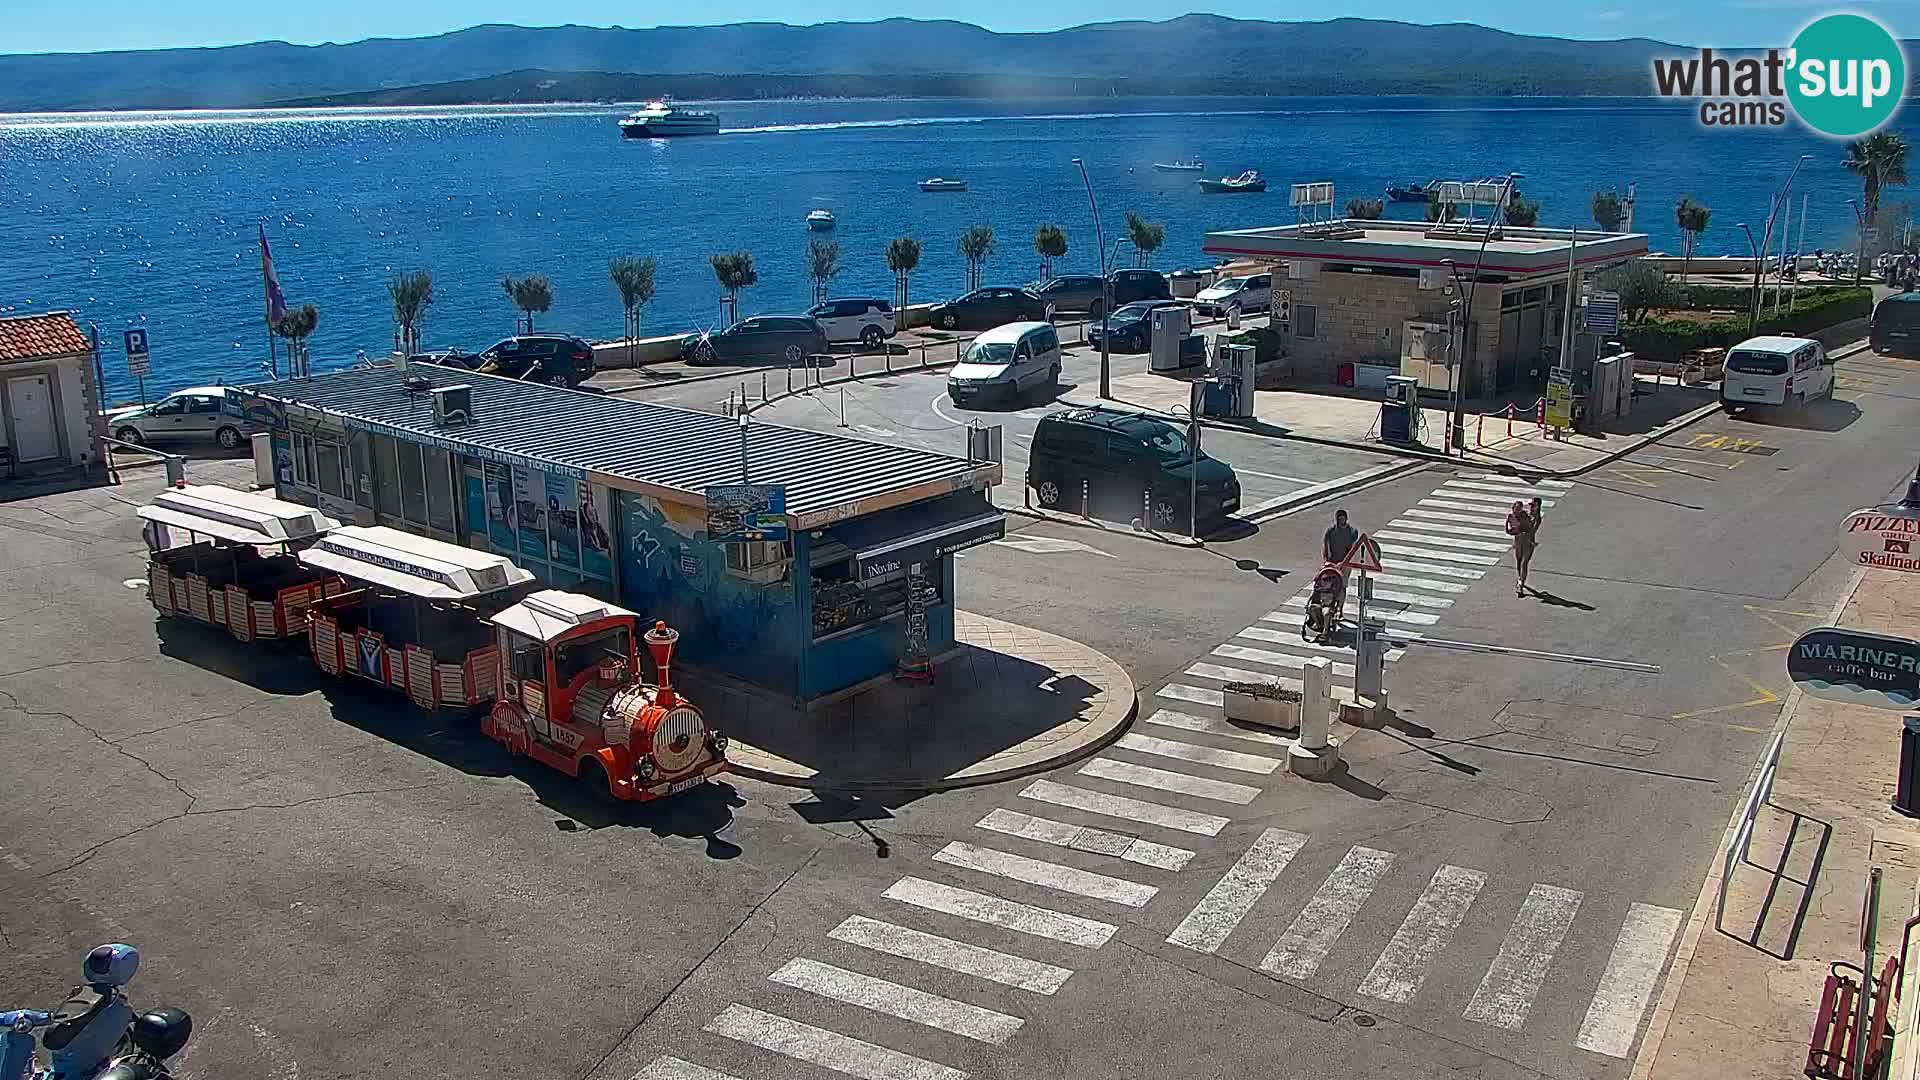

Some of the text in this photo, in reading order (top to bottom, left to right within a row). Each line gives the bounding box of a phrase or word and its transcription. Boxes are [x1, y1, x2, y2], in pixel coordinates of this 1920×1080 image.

[130, 333, 142, 351] P
[478, 448, 492, 458] BUS
[495, 451, 525, 467] STATION
[528, 459, 553, 474] TICKET
[555, 464, 581, 480] OFFICE
[1848, 516, 1920, 534] PIZZE
[1881, 531, 1916, 542] GRILL
[1870, 667, 1897, 681] bar
